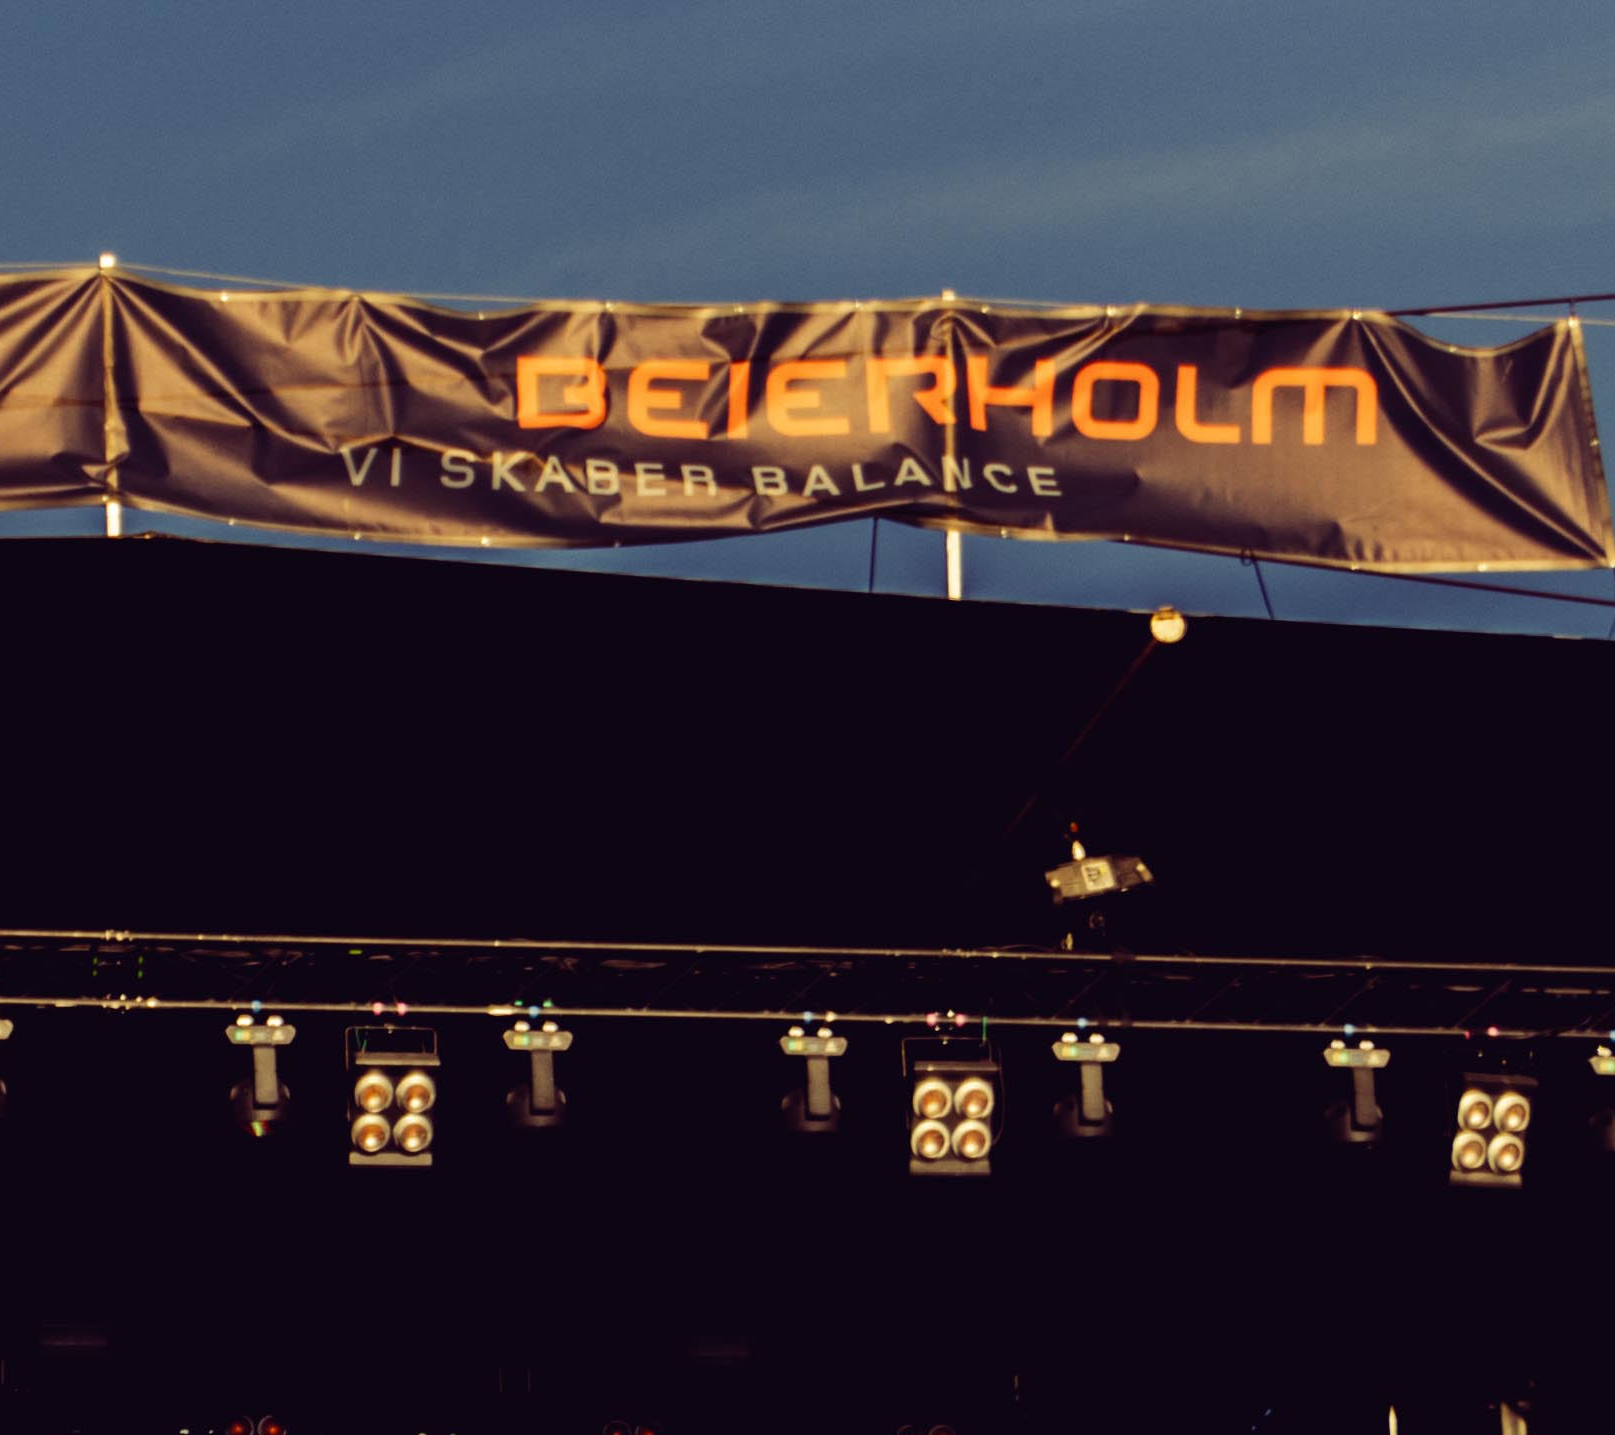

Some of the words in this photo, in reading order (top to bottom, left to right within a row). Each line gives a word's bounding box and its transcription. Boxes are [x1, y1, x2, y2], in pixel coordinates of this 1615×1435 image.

[514, 353, 1379, 448] BEIERHOLM
[342, 445, 405, 489] VI
[440, 449, 720, 498] SKABER
[753, 456, 1061, 500] BALANCE
